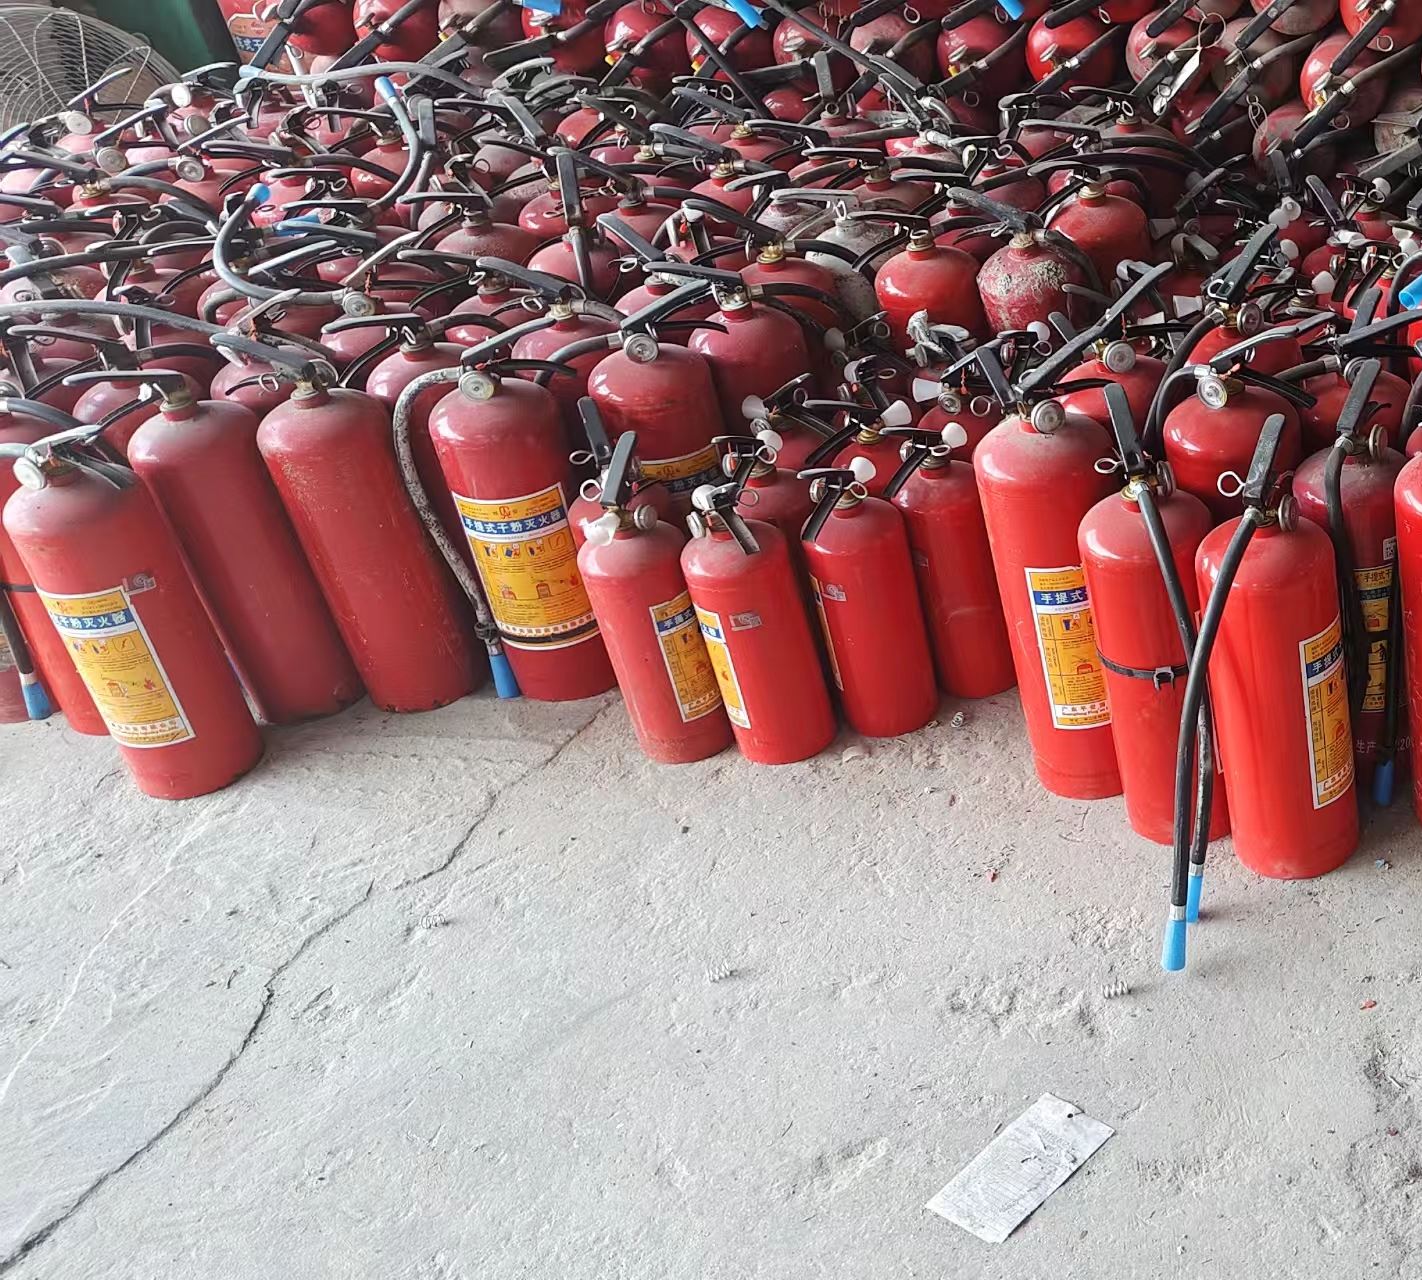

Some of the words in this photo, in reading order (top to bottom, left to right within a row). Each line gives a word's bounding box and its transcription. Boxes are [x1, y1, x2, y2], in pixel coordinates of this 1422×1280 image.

[465, 508, 562, 533] 手提式干粉灭火器
[1041, 590, 1087, 604] 手提式
